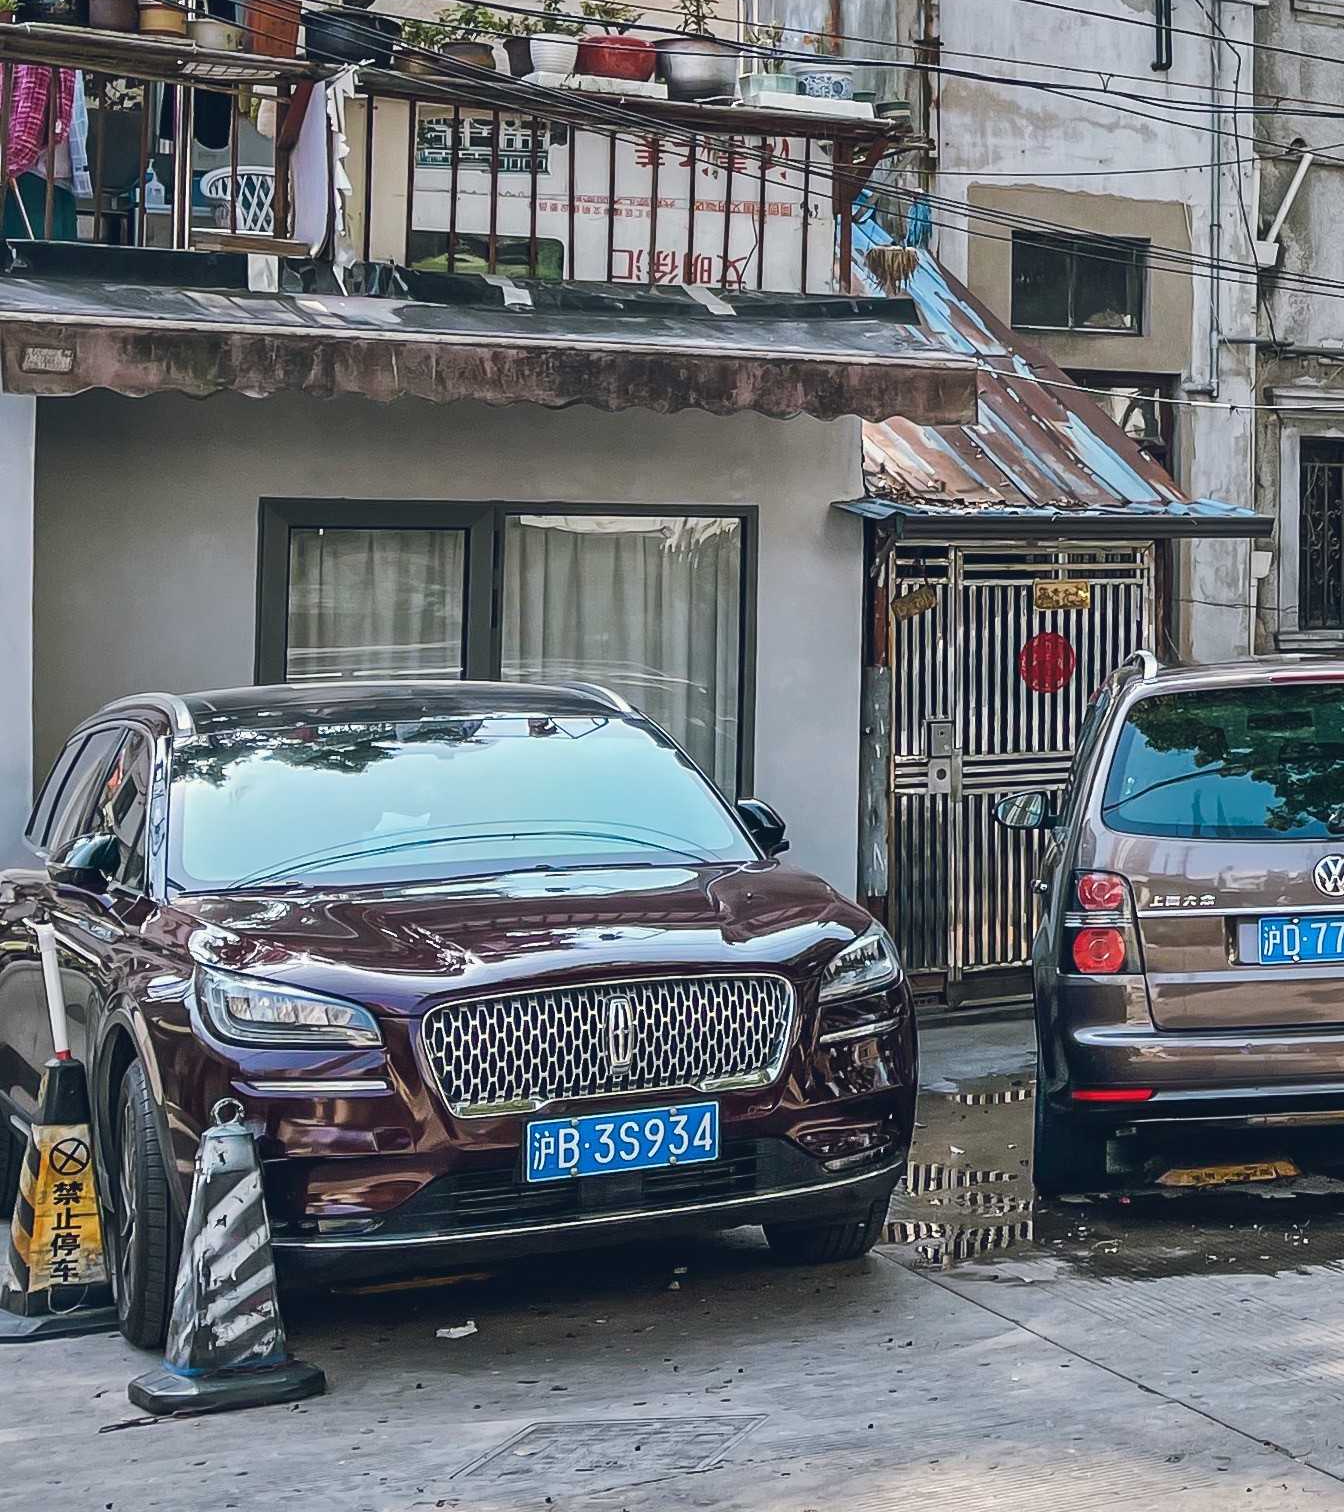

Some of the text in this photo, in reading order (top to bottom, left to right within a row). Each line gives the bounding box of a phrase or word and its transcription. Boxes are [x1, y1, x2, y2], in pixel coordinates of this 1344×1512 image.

[611, 249, 748, 290] 文明徐汇
[48, 1180, 83, 1282] 禁止停车
